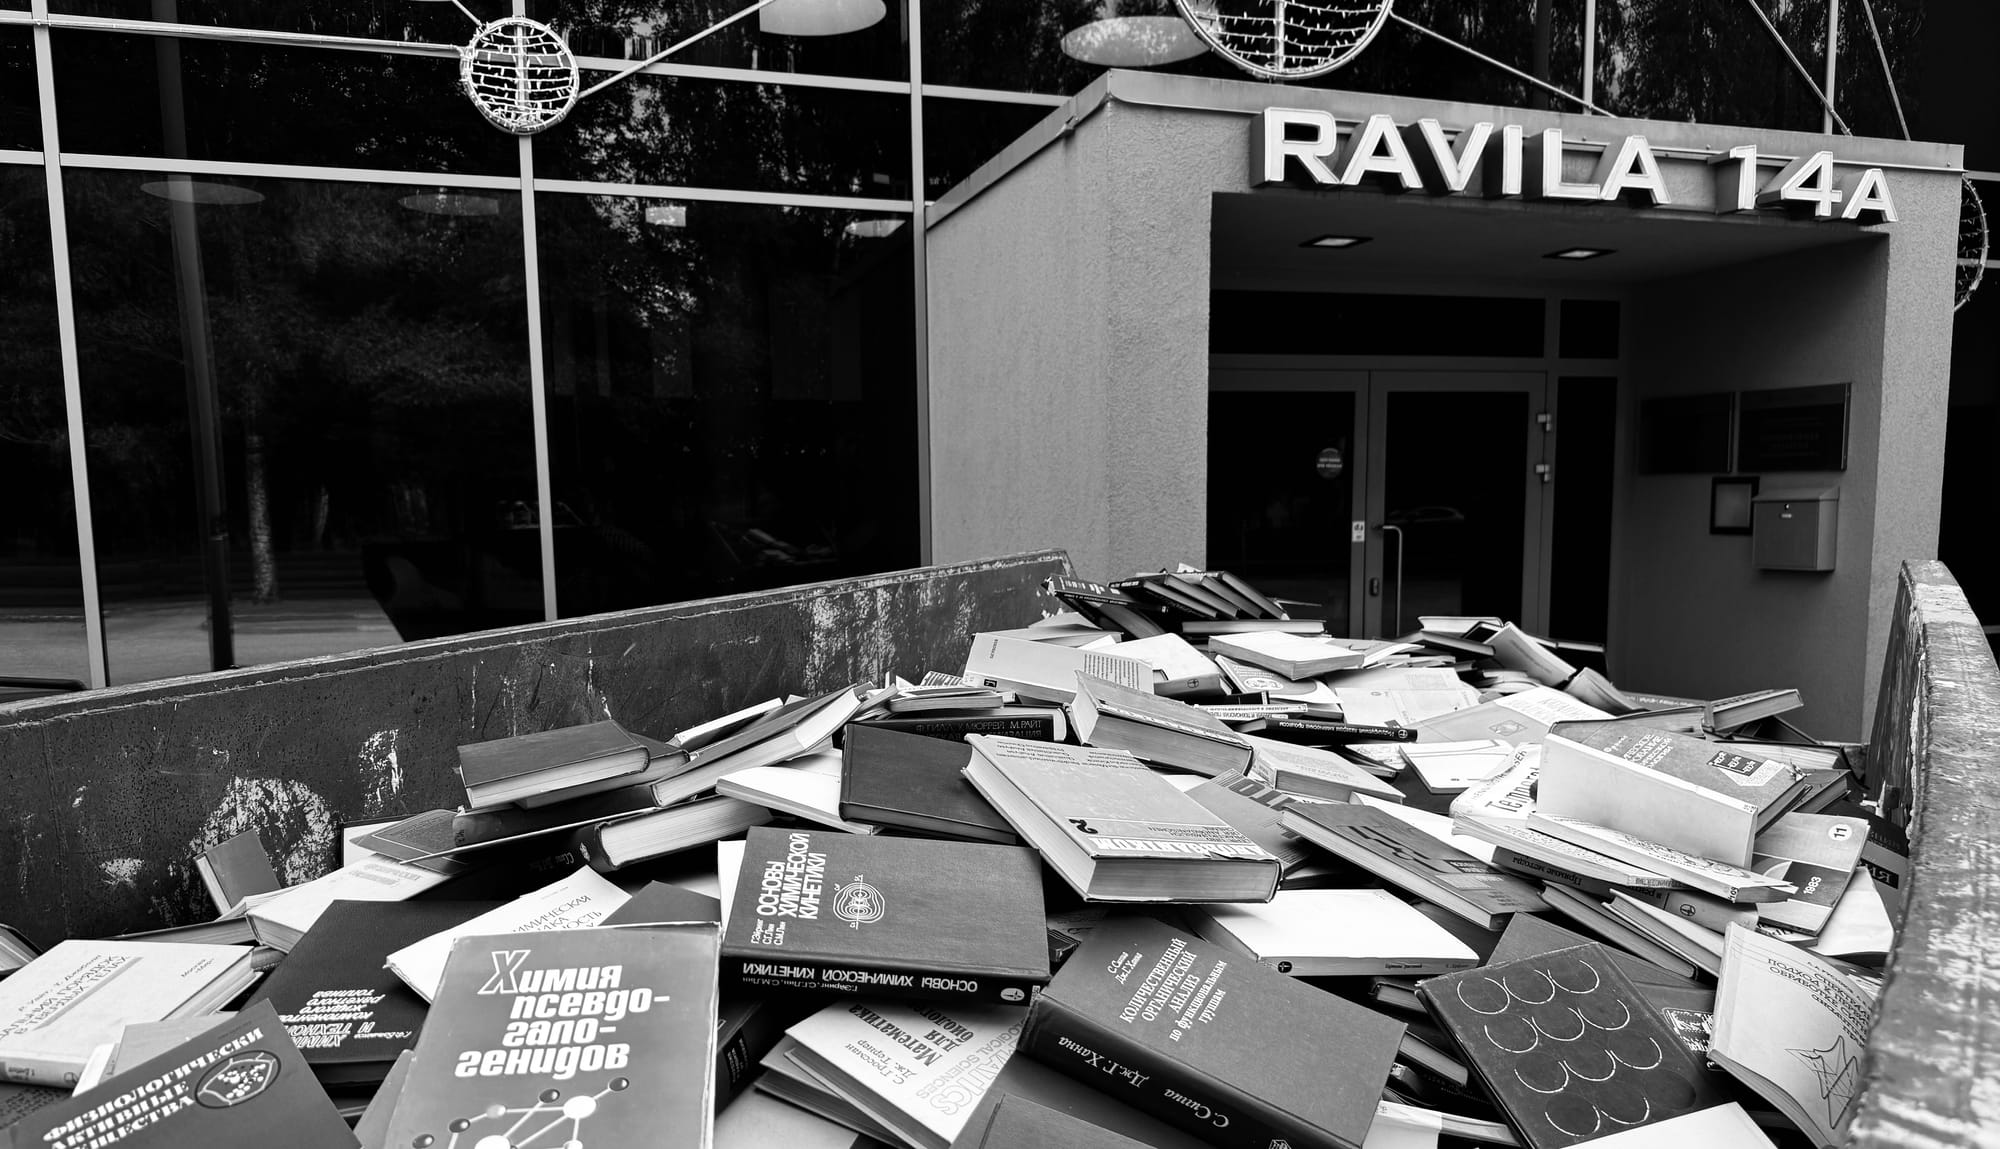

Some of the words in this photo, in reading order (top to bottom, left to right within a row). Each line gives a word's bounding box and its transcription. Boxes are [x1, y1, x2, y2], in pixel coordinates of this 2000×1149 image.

[1258, 105, 1672, 205] RAVILA
[1722, 144, 1899, 222] 14A
[756, 861, 785, 916] ОСНОВЫ
[777, 832, 810, 918] ХИМИЧЕСКОЙ
[798, 852, 827, 920] КИНЕТИКИ
[1803, 876, 1822, 895] 1983
[512, 895, 592, 932] ИМИЧЕСКАЯ
[478, 949, 623, 996] Химия
[742, 962, 815, 980] КИНЕТИКИ
[822, 968, 914, 988] ХИМИЧЕСКОЙ
[921, 976, 978, 993] ОСНОВЫ
[1119, 937, 1188, 1025] КОЛИЧЕСТВЕННЫЙ
[1141, 950, 1197, 1022] ОРГАНИЧЕСКИЙ
[1767, 958, 1821, 986] ПОДХОД
[510, 987, 670, 1020] псевдо-
[1169, 973, 1201, 1015] АНАЛИЗ
[1169, 1026, 1183, 1042] по
[1177, 959, 1228, 1031] функциональным
[1197, 988, 1227, 1025] группам
[279, 1011, 374, 1023] компоненто
[284, 1022, 352, 1037] ТЕХНО
[502, 1017, 617, 1048] гало-
[848, 1003, 943, 1067] Математика
[290, 1034, 348, 1049] ХИМИ
[857, 1039, 892, 1066] Тернер
[924, 1029, 960, 1053] для
[975, 1017, 1026, 1057] LOGICAL
[1058, 1035, 1106, 1067] Ханна
[454, 1043, 631, 1081] генидов
[845, 1043, 891, 1077] Гроссман
[894, 1061, 918, 1079] Дж.
[915, 1055, 981, 1099] SCIENCES
[43, 1027, 265, 1142] ФИЗИОЛОГИЧЕСКИ
[892, 1074, 905, 1085] С.
[73, 1096, 196, 1149] ЩЕСТВА
